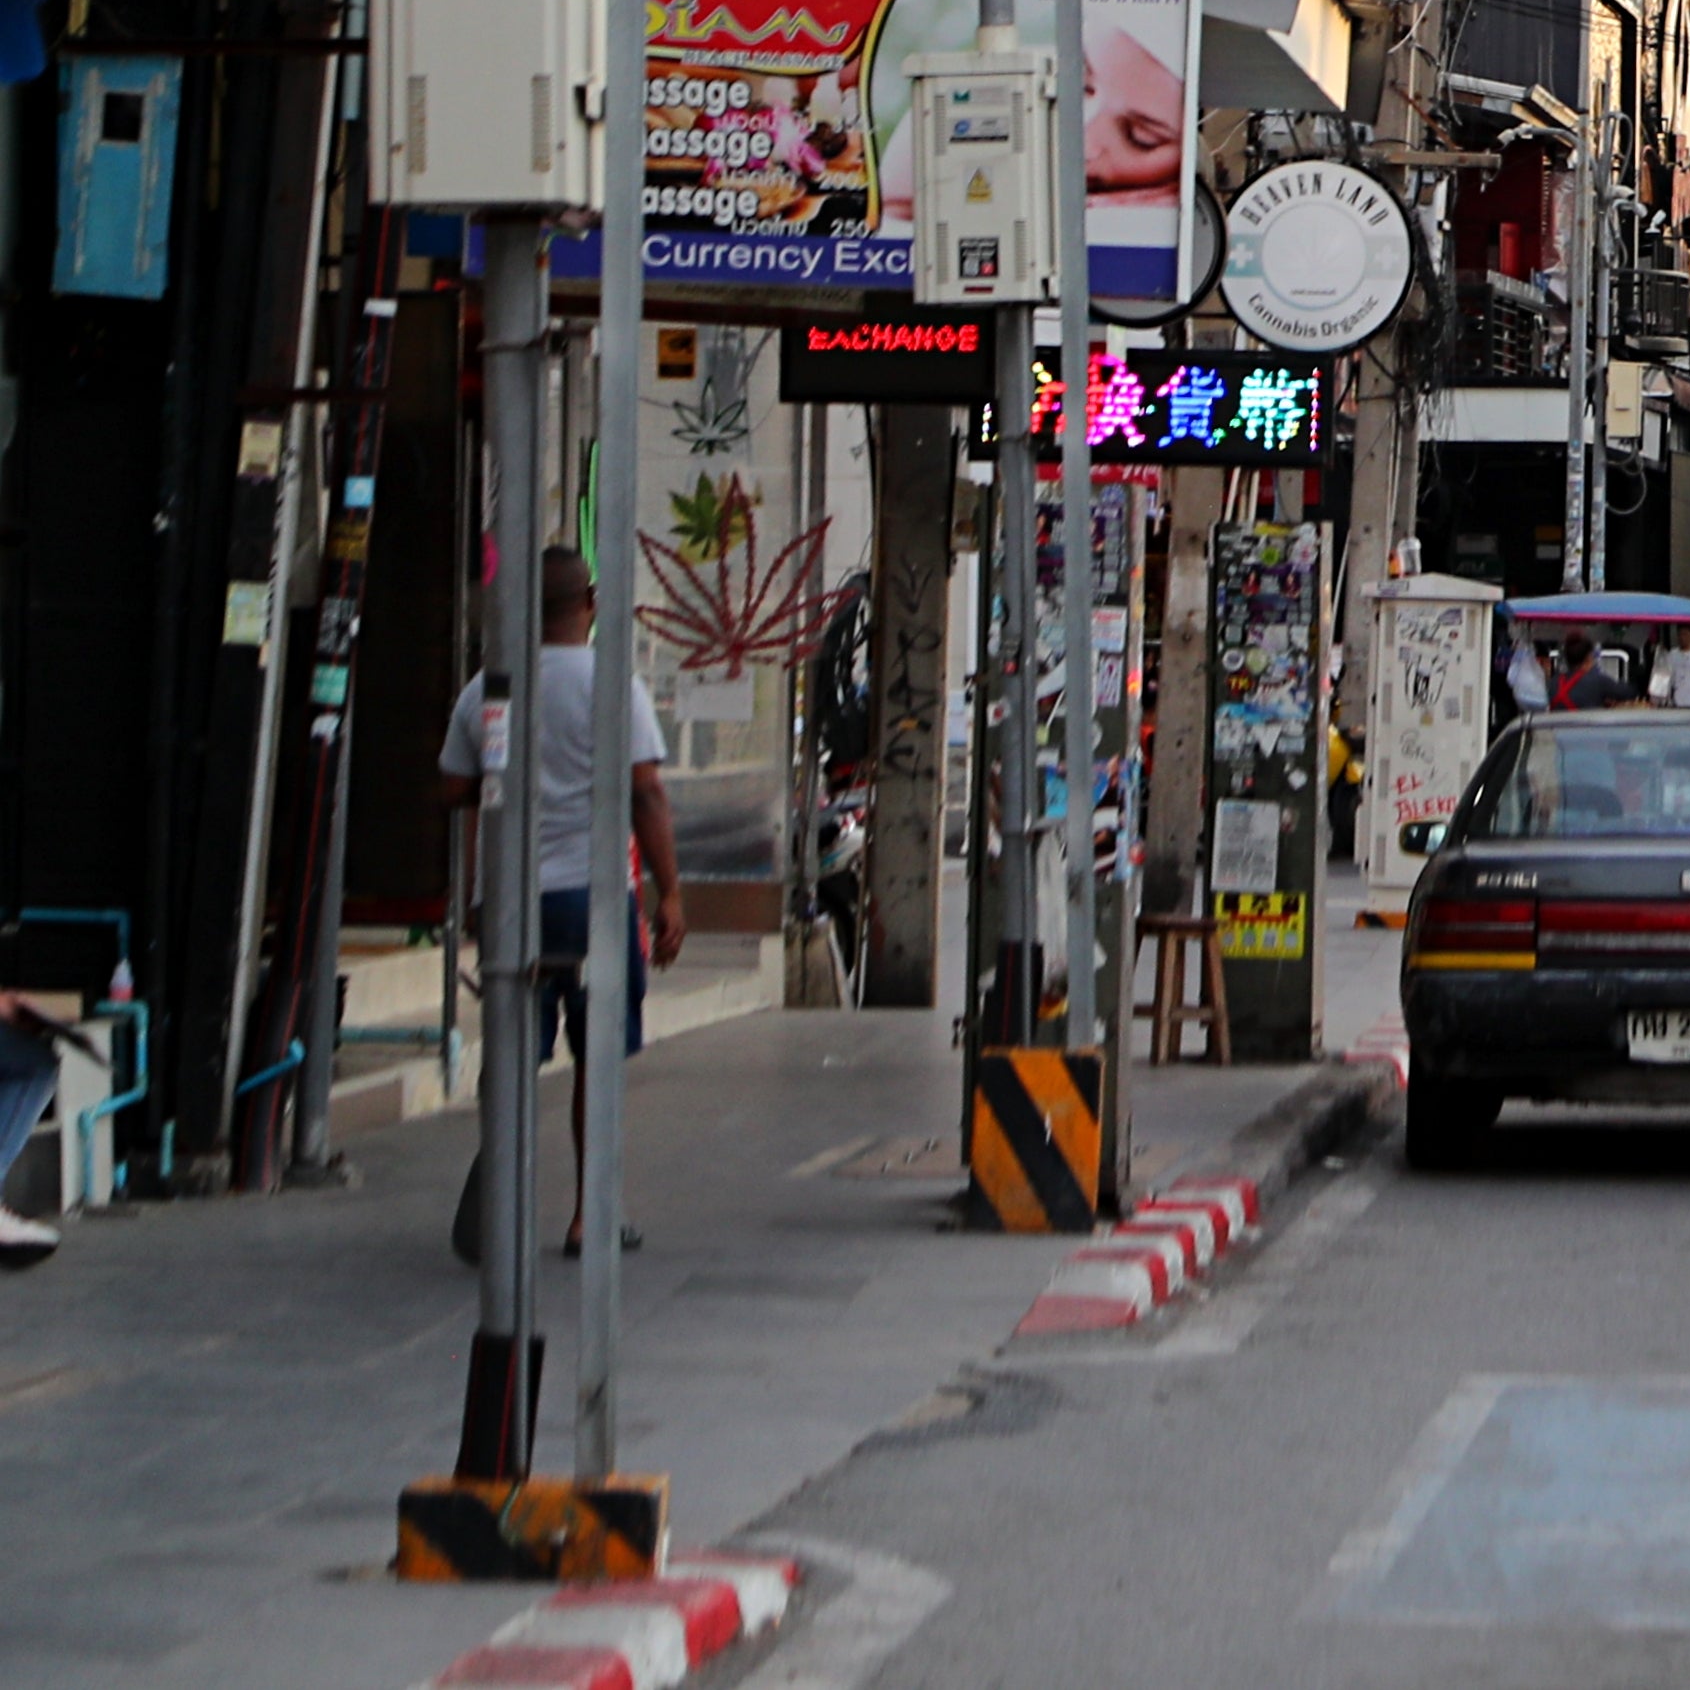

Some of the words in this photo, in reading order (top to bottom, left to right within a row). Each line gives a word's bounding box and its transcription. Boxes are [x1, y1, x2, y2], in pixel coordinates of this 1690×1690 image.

[643, 129, 771, 168] assage
[1239, 172, 1323, 227] HEAVEN
[1335, 177, 1390, 228] LAND
[641, 234, 823, 278] Currency
[1248, 292, 1317, 339] Cannabis
[1320, 293, 1381, 338] Organic
